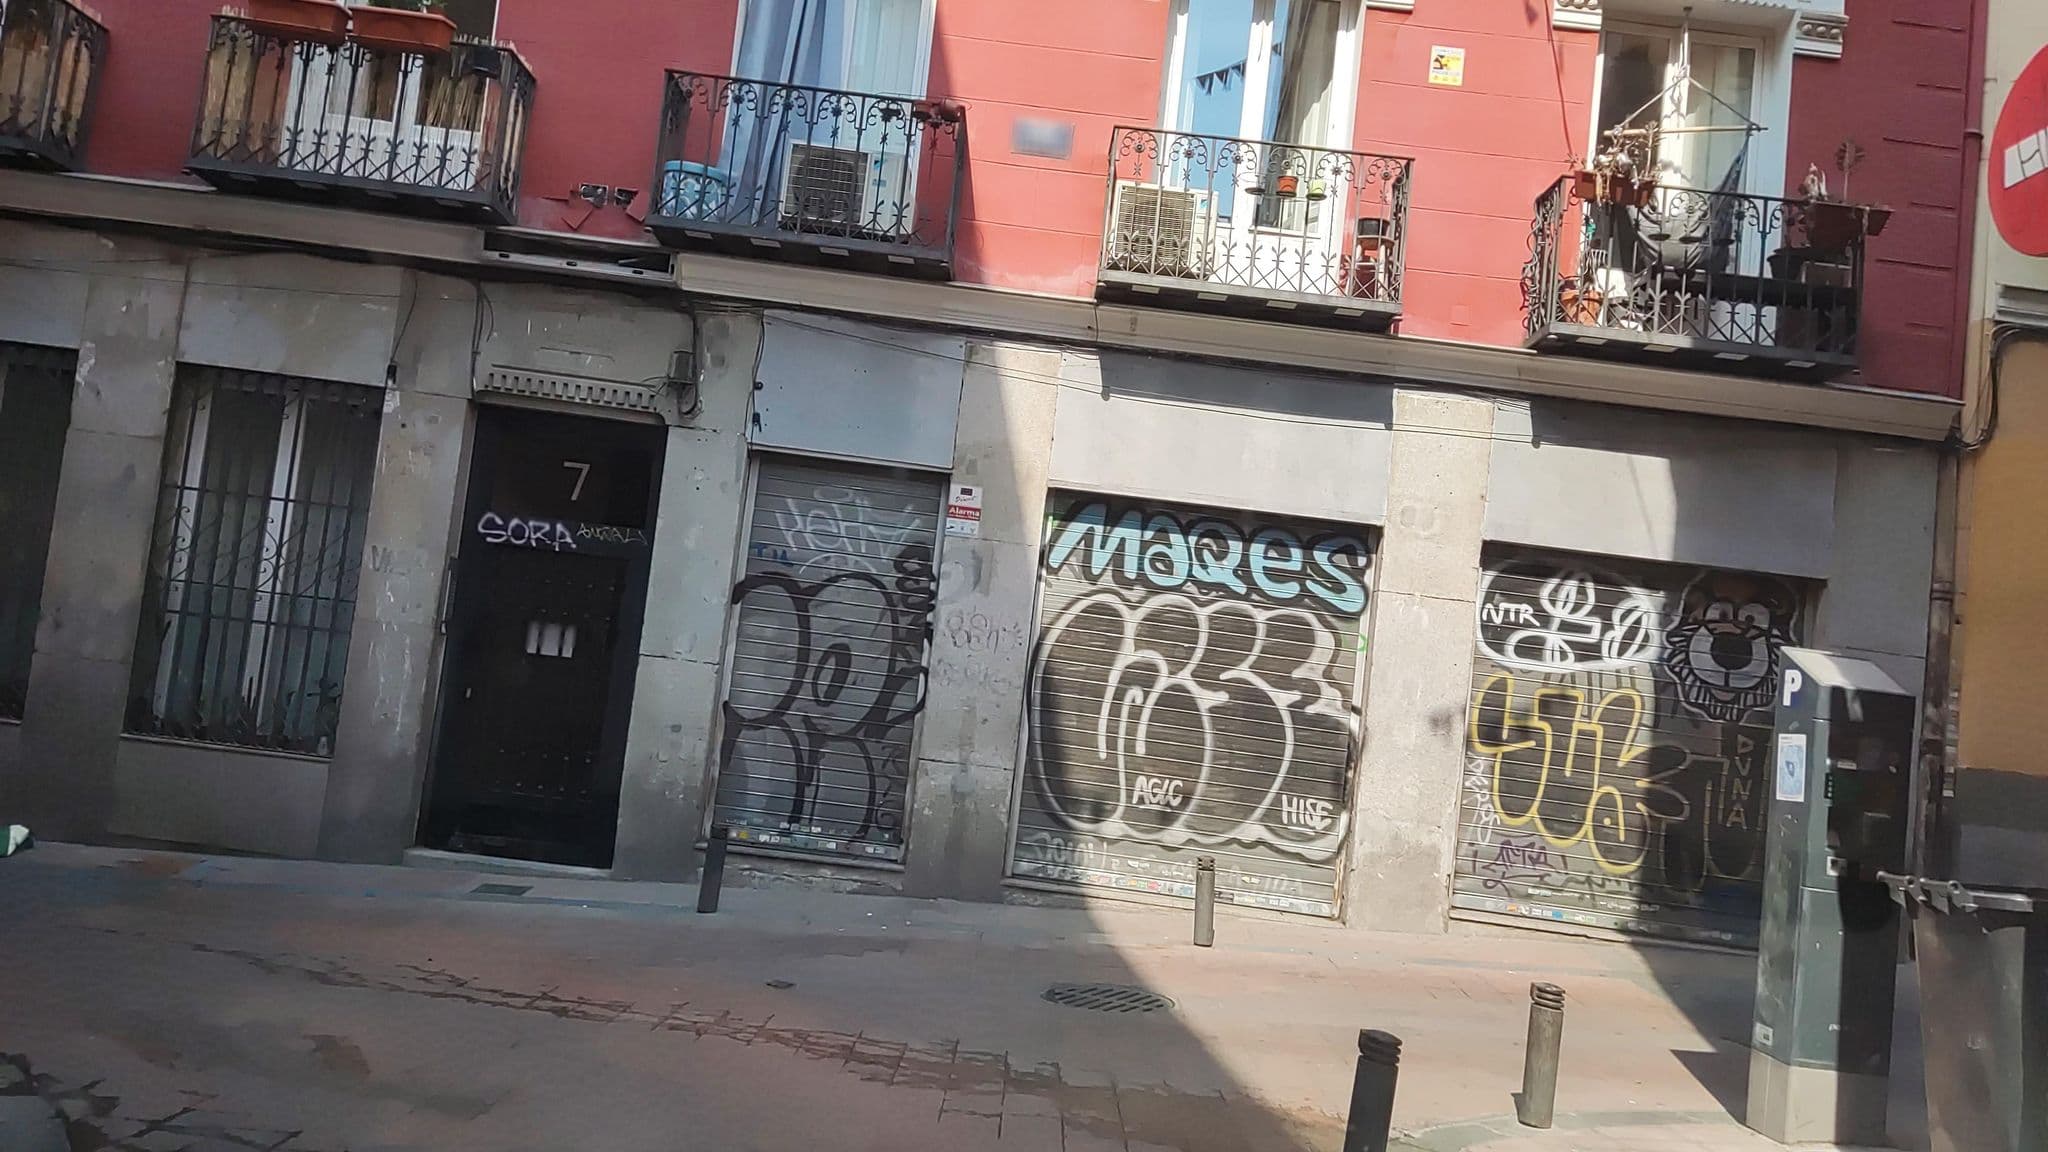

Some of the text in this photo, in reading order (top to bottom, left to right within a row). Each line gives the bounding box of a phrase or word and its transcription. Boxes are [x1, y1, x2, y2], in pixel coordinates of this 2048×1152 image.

[563, 461, 591, 501] 7
[949, 506, 980, 518] Alarma
[478, 512, 577, 551] SORA
[1482, 602, 1541, 627] NTR
[1783, 669, 1802, 706] P
